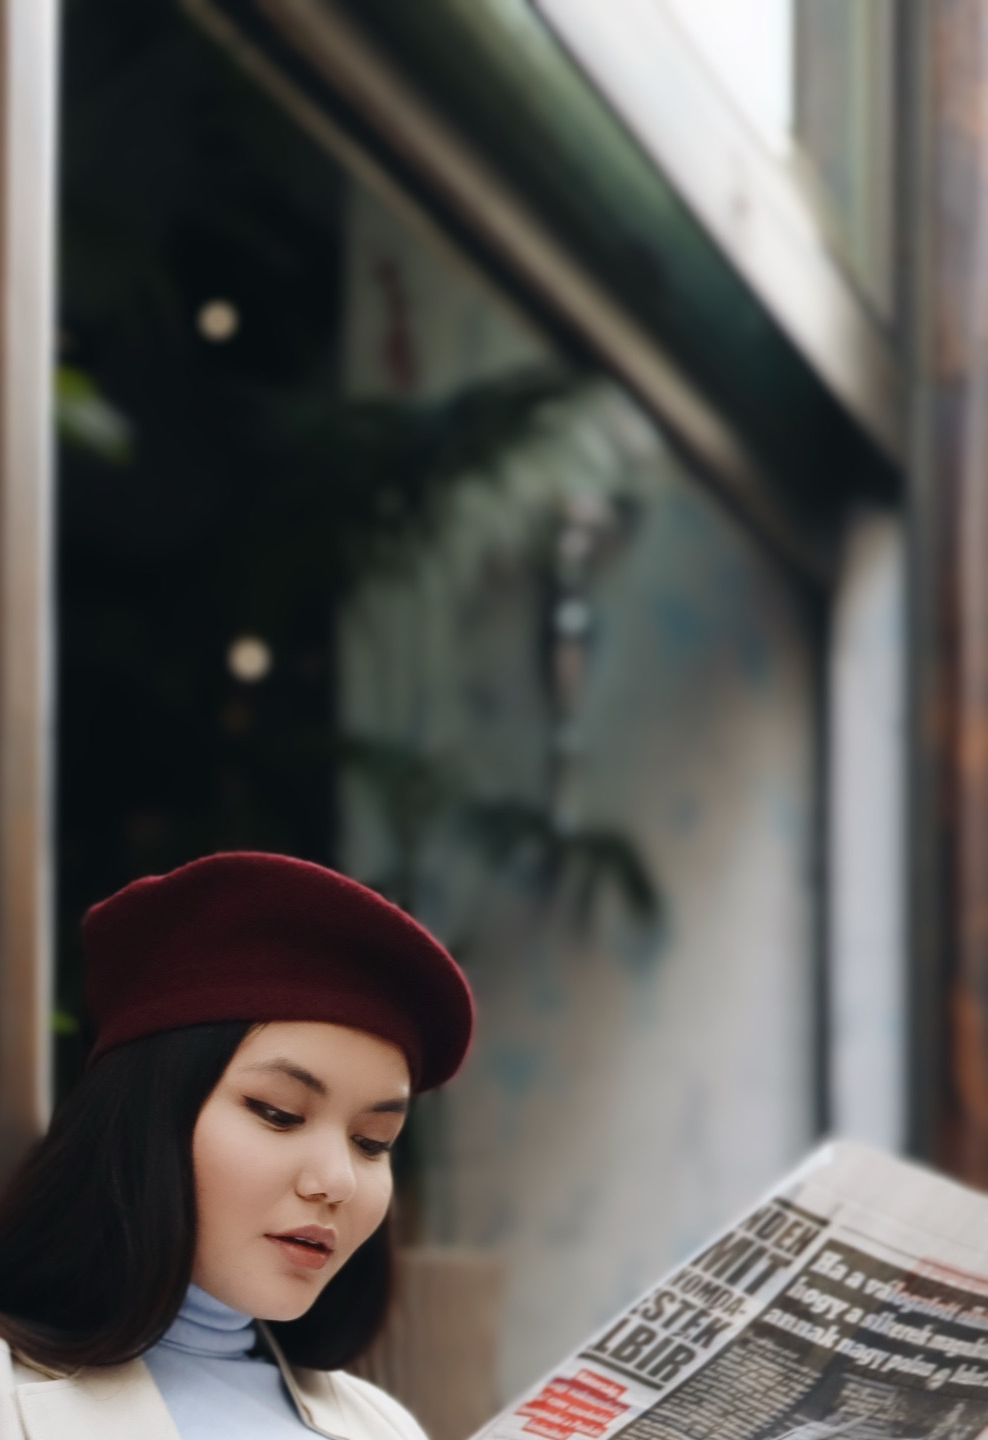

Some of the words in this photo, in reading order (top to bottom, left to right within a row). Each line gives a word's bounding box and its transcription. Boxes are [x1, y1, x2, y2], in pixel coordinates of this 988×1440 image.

[689, 1230, 794, 1297] MIT
[809, 1250, 849, 1281] Ha
[843, 1271, 866, 1290] a
[630, 1290, 733, 1349] STÉK
[785, 1275, 851, 1321] hogy
[843, 1307, 865, 1325] a
[763, 1307, 841, 1350] annak
[833, 1337, 892, 1371] nagy
